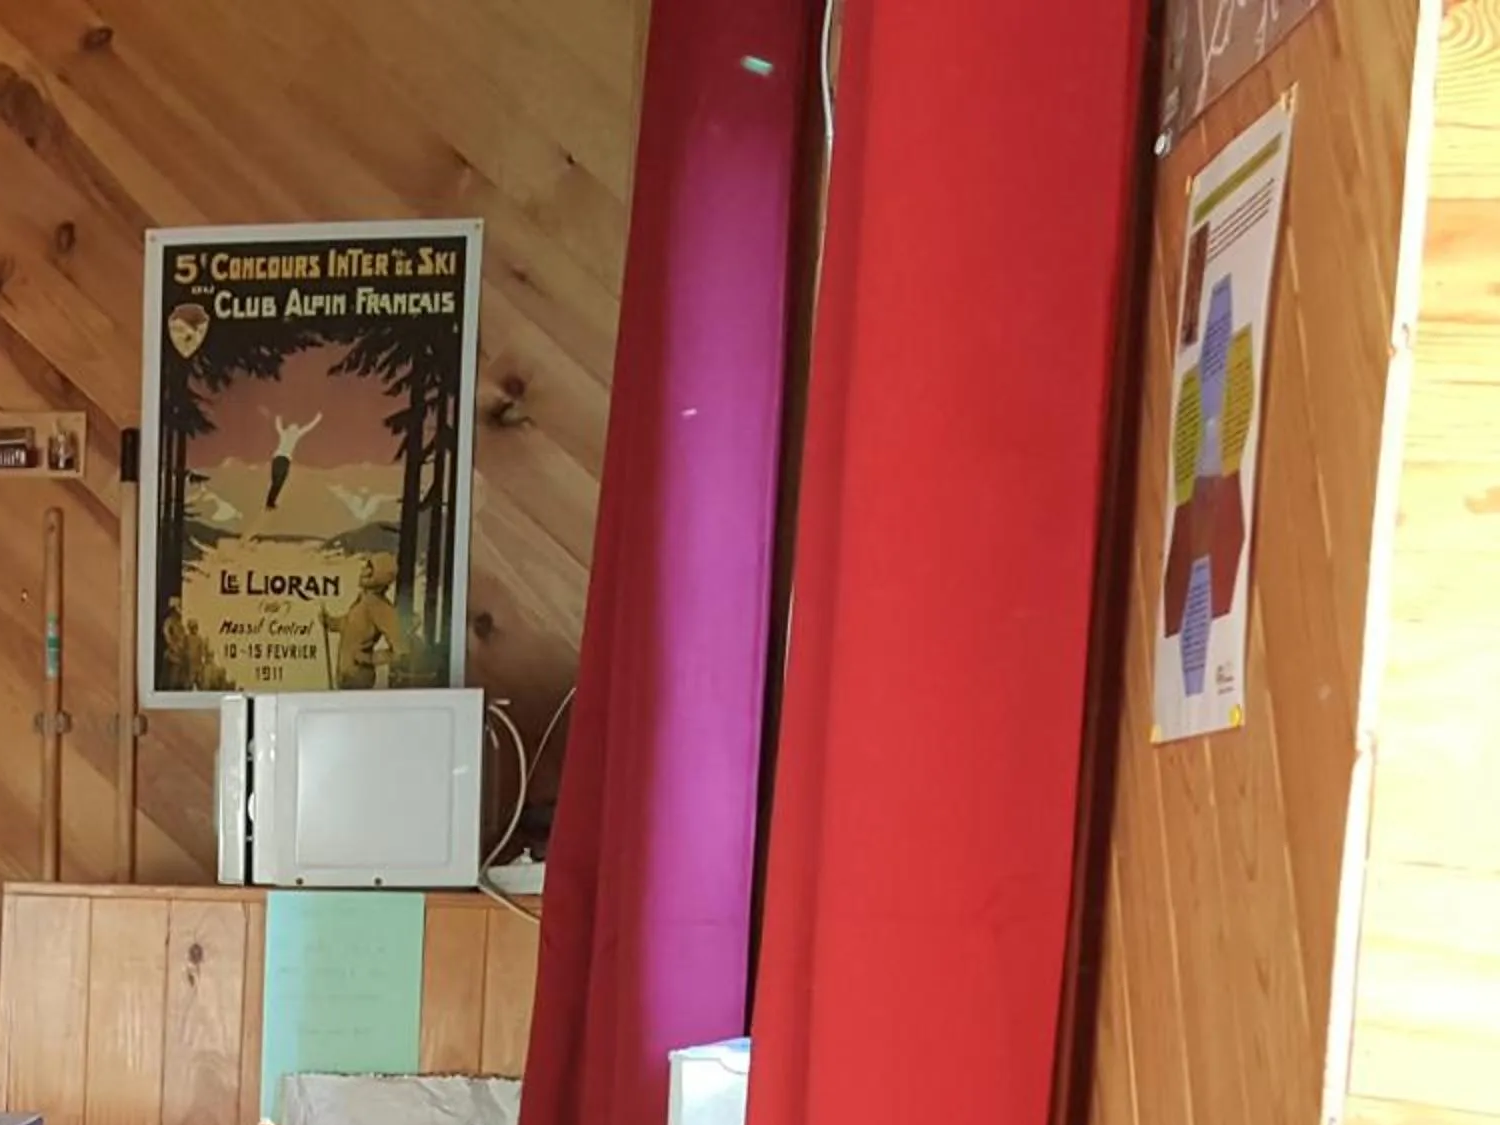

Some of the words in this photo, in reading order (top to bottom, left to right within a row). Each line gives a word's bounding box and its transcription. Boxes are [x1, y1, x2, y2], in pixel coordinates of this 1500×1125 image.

[211, 252, 321, 281] CONCOURS
[417, 246, 456, 276] SKI
[214, 289, 277, 319] CLUB
[284, 288, 347, 317] ALPIN
[221, 569, 240, 595] LE
[247, 570, 340, 601] LIORAN
[269, 619, 314, 636] Central
